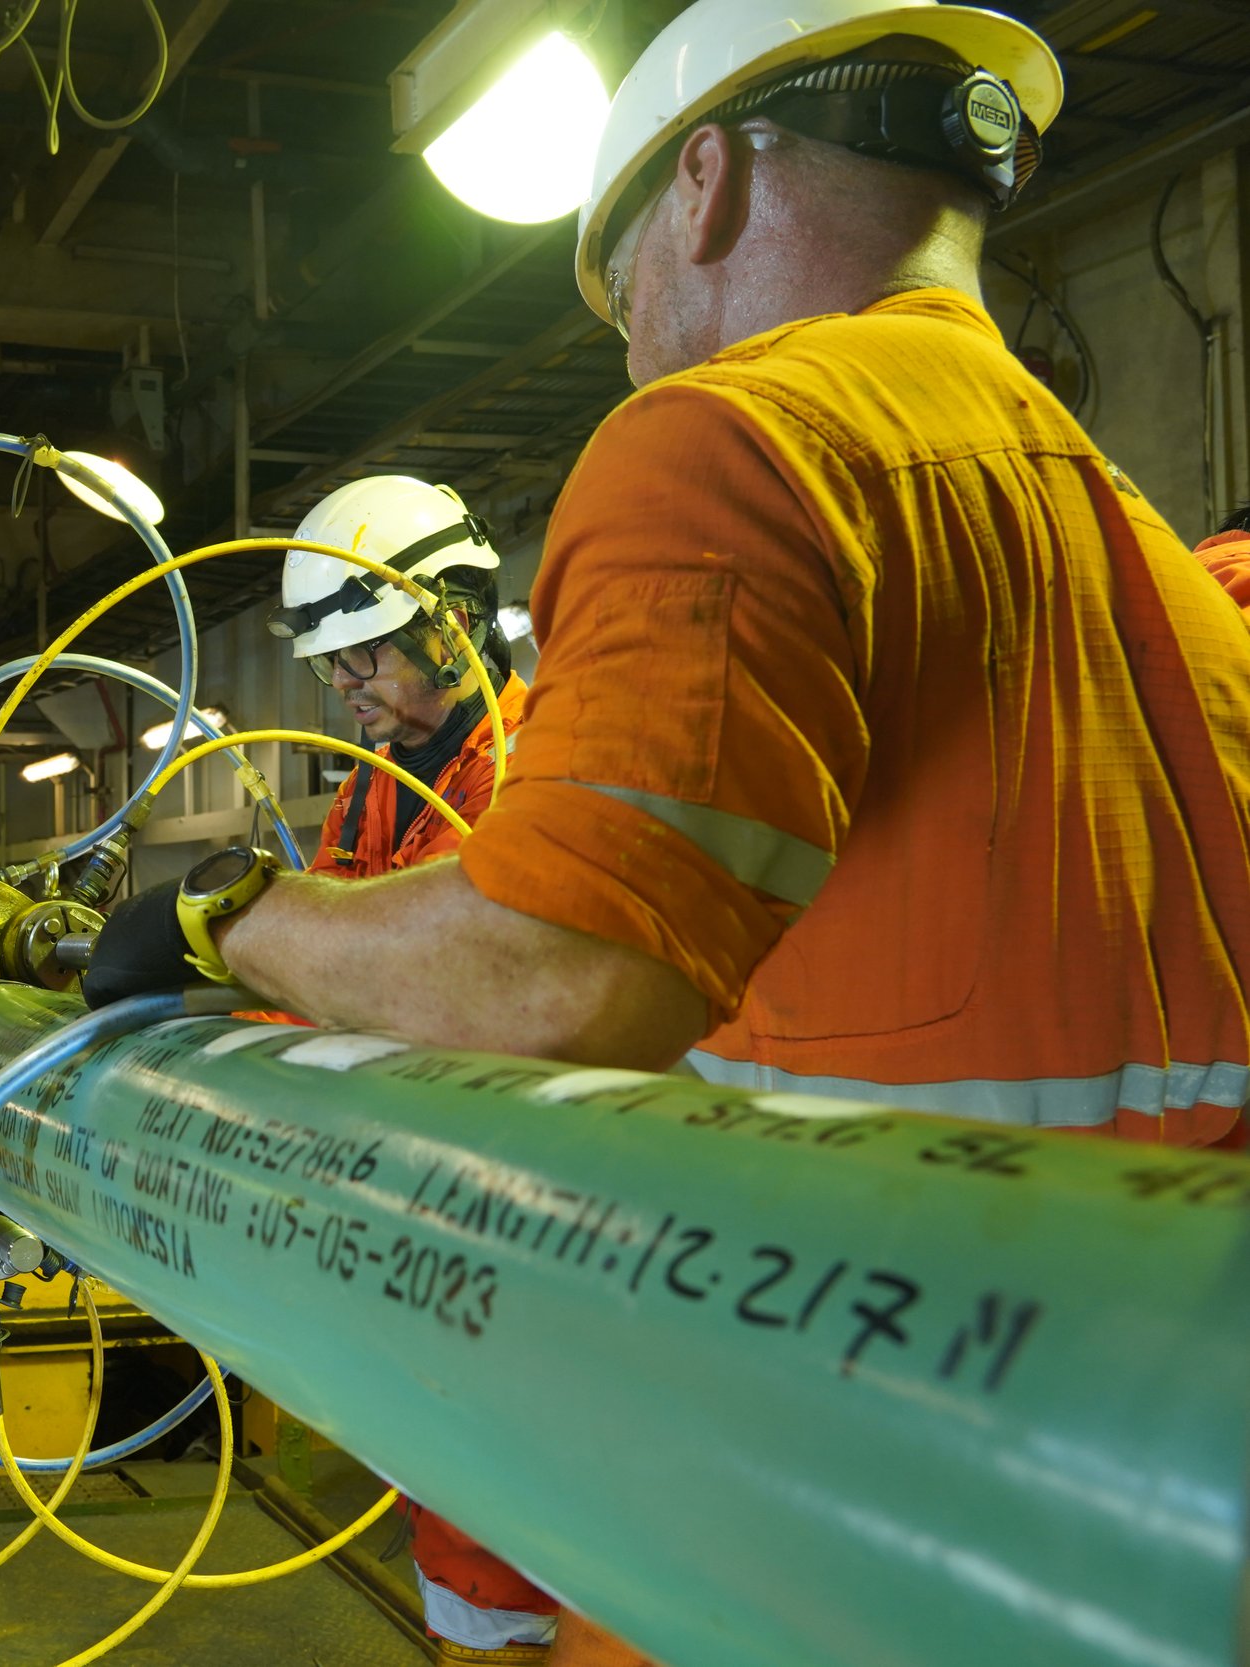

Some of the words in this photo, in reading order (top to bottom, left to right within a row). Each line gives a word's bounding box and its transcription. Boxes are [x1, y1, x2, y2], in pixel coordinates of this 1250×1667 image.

[972, 102, 1008, 128] MSA
[136, 1096, 203, 1143] HEAT
[54, 1121, 96, 1171] DATE
[100, 1137, 127, 1181] OF
[134, 1146, 234, 1225] COATING
[91, 1188, 197, 1280] INDONESIA
